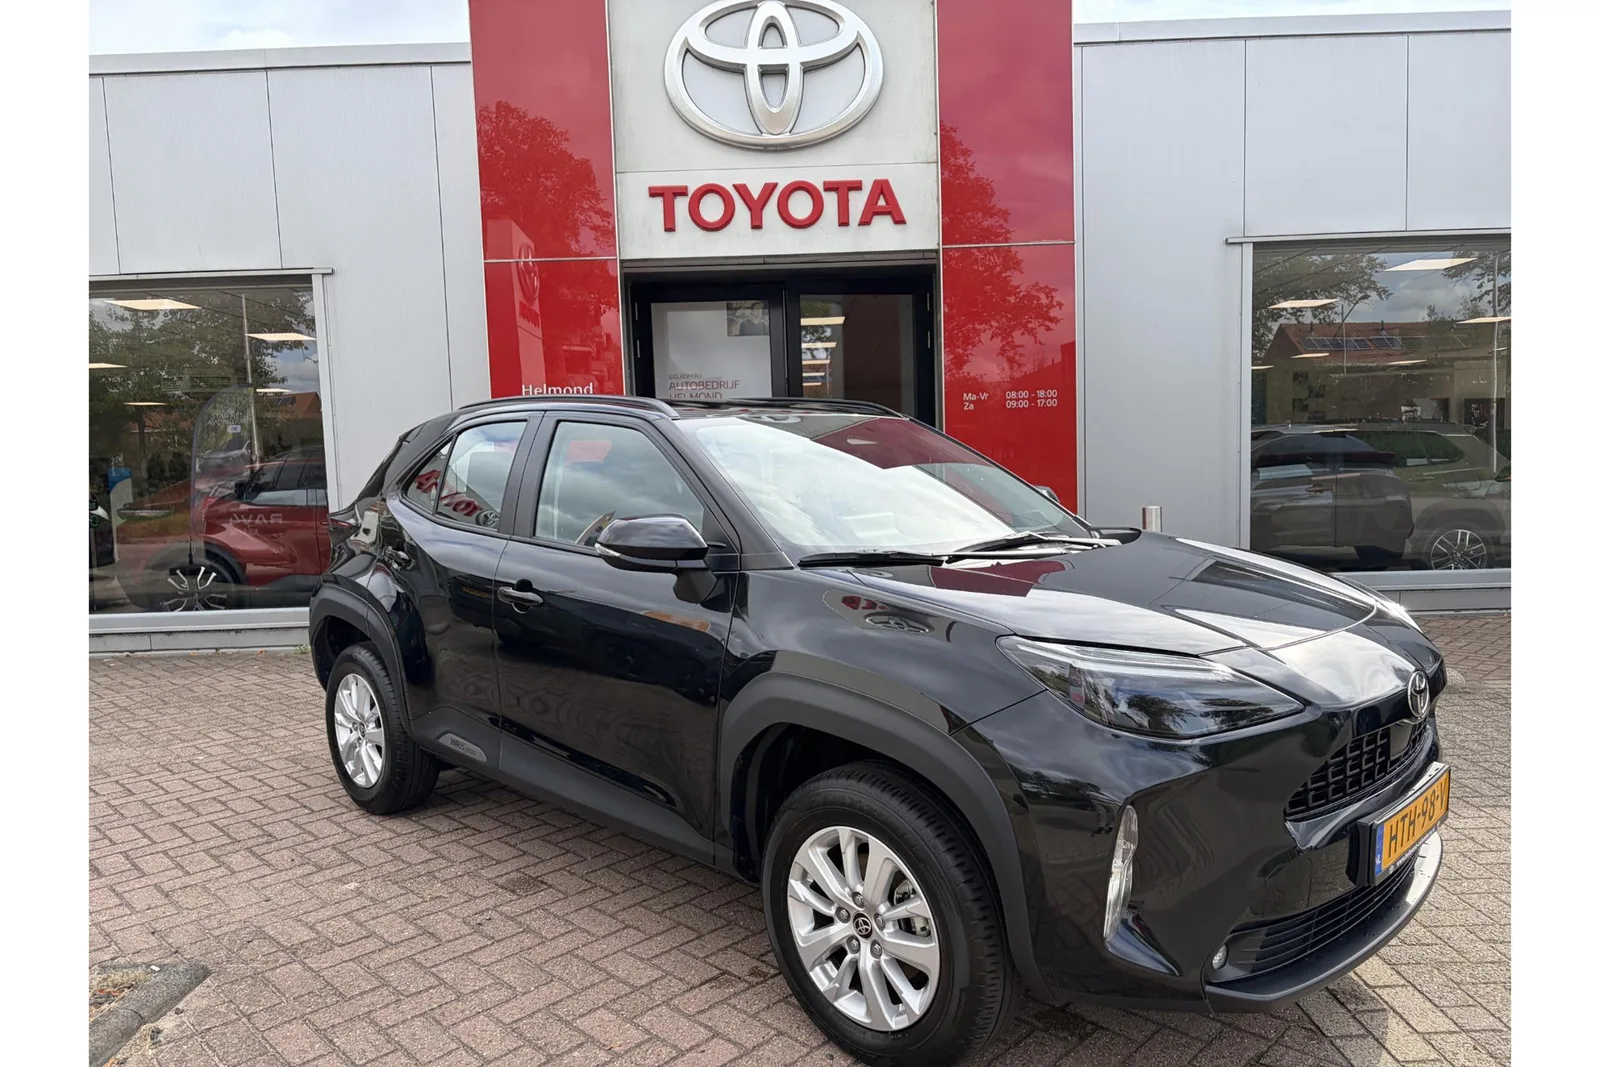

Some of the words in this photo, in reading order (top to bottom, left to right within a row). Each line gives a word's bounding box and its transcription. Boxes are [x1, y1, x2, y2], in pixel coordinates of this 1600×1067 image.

[648, 179, 907, 232] TOYOTA
[522, 382, 594, 396] Helmond
[668, 380, 740, 391] AUTOBEDRIJF
[963, 392, 989, 401] Ma-Vr
[1005, 390, 1029, 399] 08:00
[1036, 389, 1058, 398] 18:00
[963, 402, 975, 410] Za
[1005, 400, 1029, 408] 09:00
[1036, 398, 1058, 407] 17:00
[1388, 778, 1448, 859] HTH-98-V
